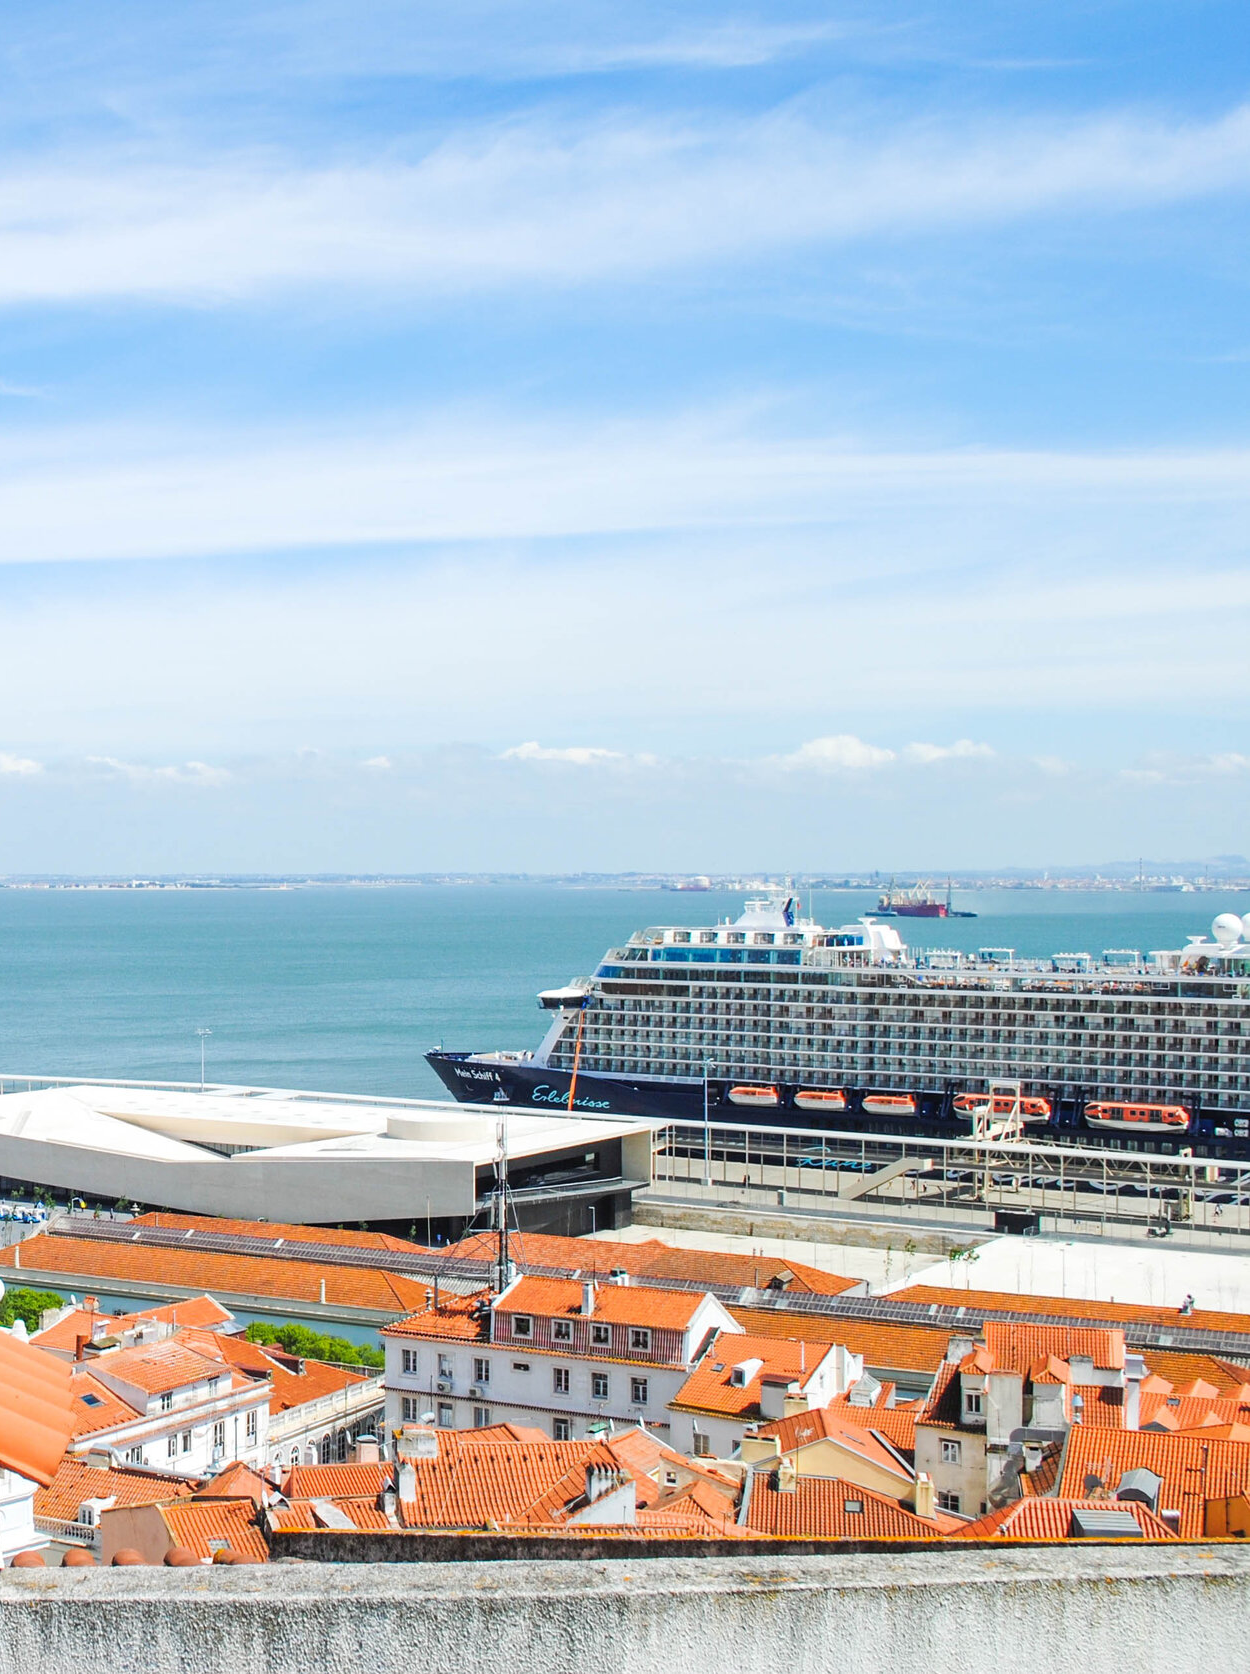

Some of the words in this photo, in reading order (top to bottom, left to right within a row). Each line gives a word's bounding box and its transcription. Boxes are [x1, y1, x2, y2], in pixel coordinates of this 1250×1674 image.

[454, 1067, 471, 1078] Mein
[471, 1070, 493, 1081] Schiff
[495, 1072, 501, 1082] 4
